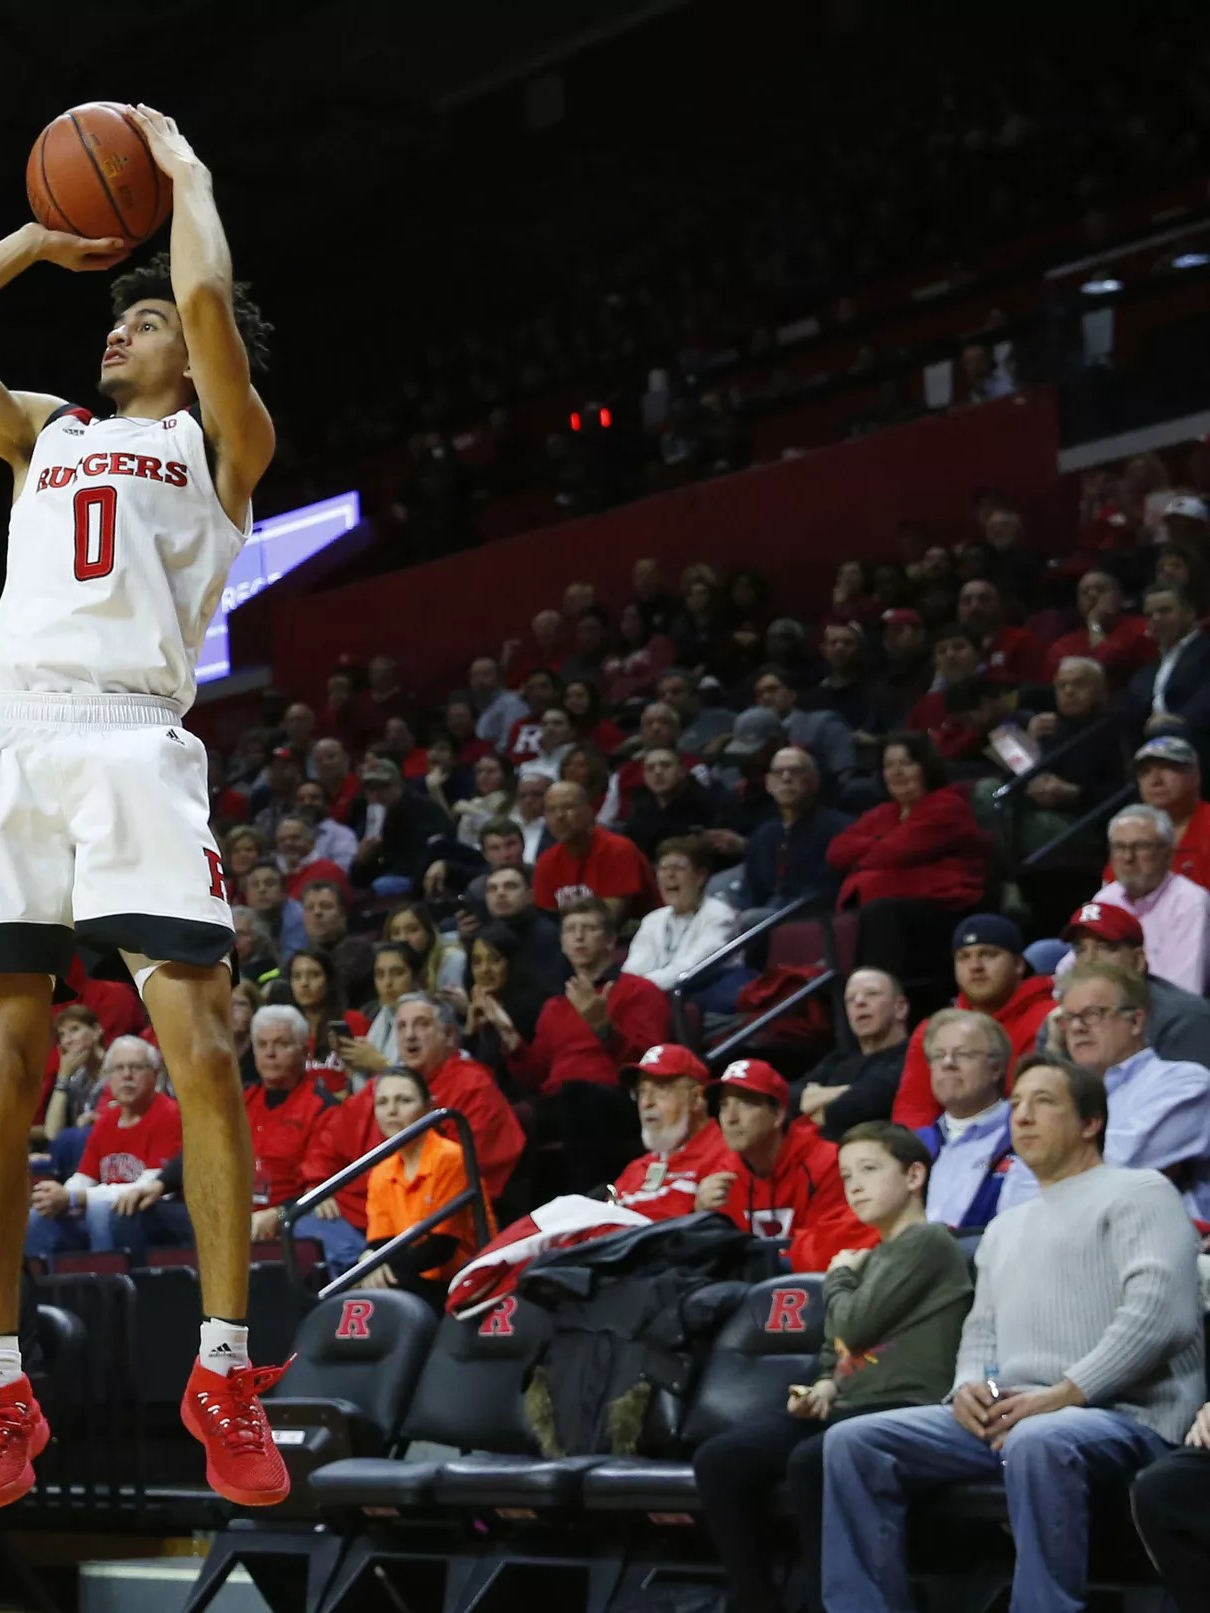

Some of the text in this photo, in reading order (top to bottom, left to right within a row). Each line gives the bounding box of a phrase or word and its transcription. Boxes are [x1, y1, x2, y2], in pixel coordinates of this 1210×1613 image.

[73, 485, 118, 582] 0
[513, 725, 542, 753] R
[1079, 903, 1103, 922] R
[335, 1299, 374, 1339] R
[478, 1296, 517, 1336] R
[764, 1287, 809, 1333] R
